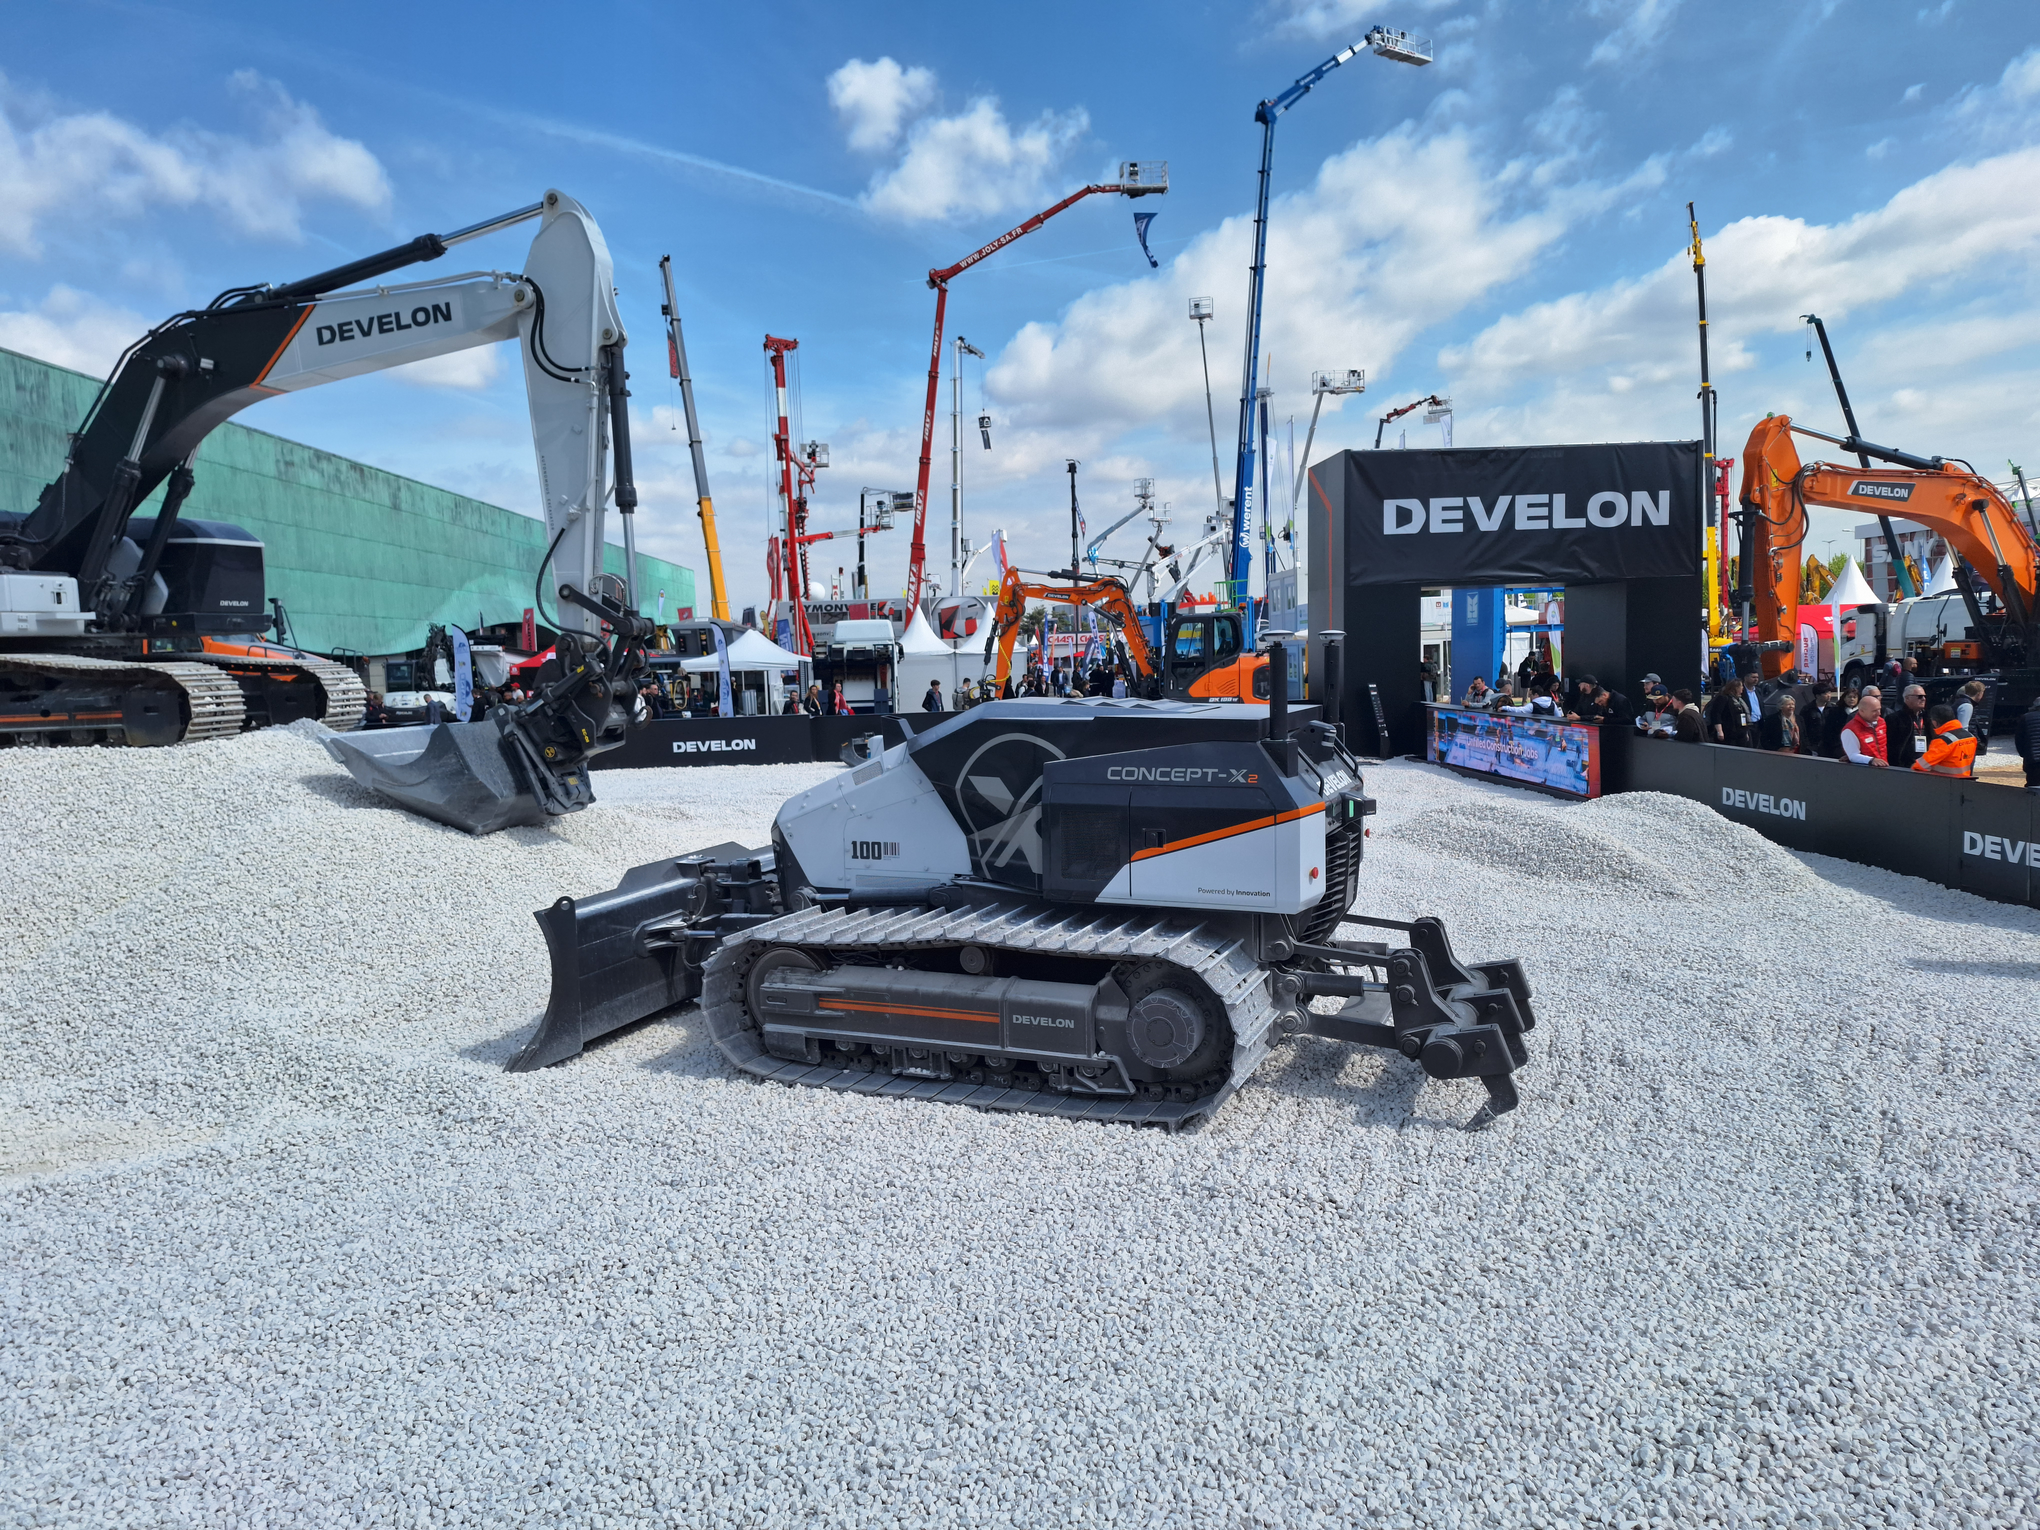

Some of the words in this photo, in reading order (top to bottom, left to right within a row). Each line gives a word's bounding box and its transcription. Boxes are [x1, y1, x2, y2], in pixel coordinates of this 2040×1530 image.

[959, 227, 1023, 268] WWW.JOLY-SA.FR
[316, 302, 452, 346] DEVELON
[1859, 484, 1909, 498] DEVELON
[1243, 486, 1253, 531] werent
[1383, 490, 1670, 535] DEVELON
[907, 567, 918, 612] JOLY
[672, 739, 756, 753] DEVELON
[1486, 739, 1523, 756] Construction
[1524, 746, 1539, 759] Jobs
[1107, 766, 1258, 784] CONCEPT-X2
[1722, 787, 1806, 821] DEVELON
[851, 841, 882, 860] 100
[1963, 830, 2040, 869] DEVE
[1197, 887, 1226, 895] Powered
[1227, 889, 1235, 897] by
[1235, 889, 1271, 897] Innovation
[1012, 1014, 1075, 1029] DEVELON
